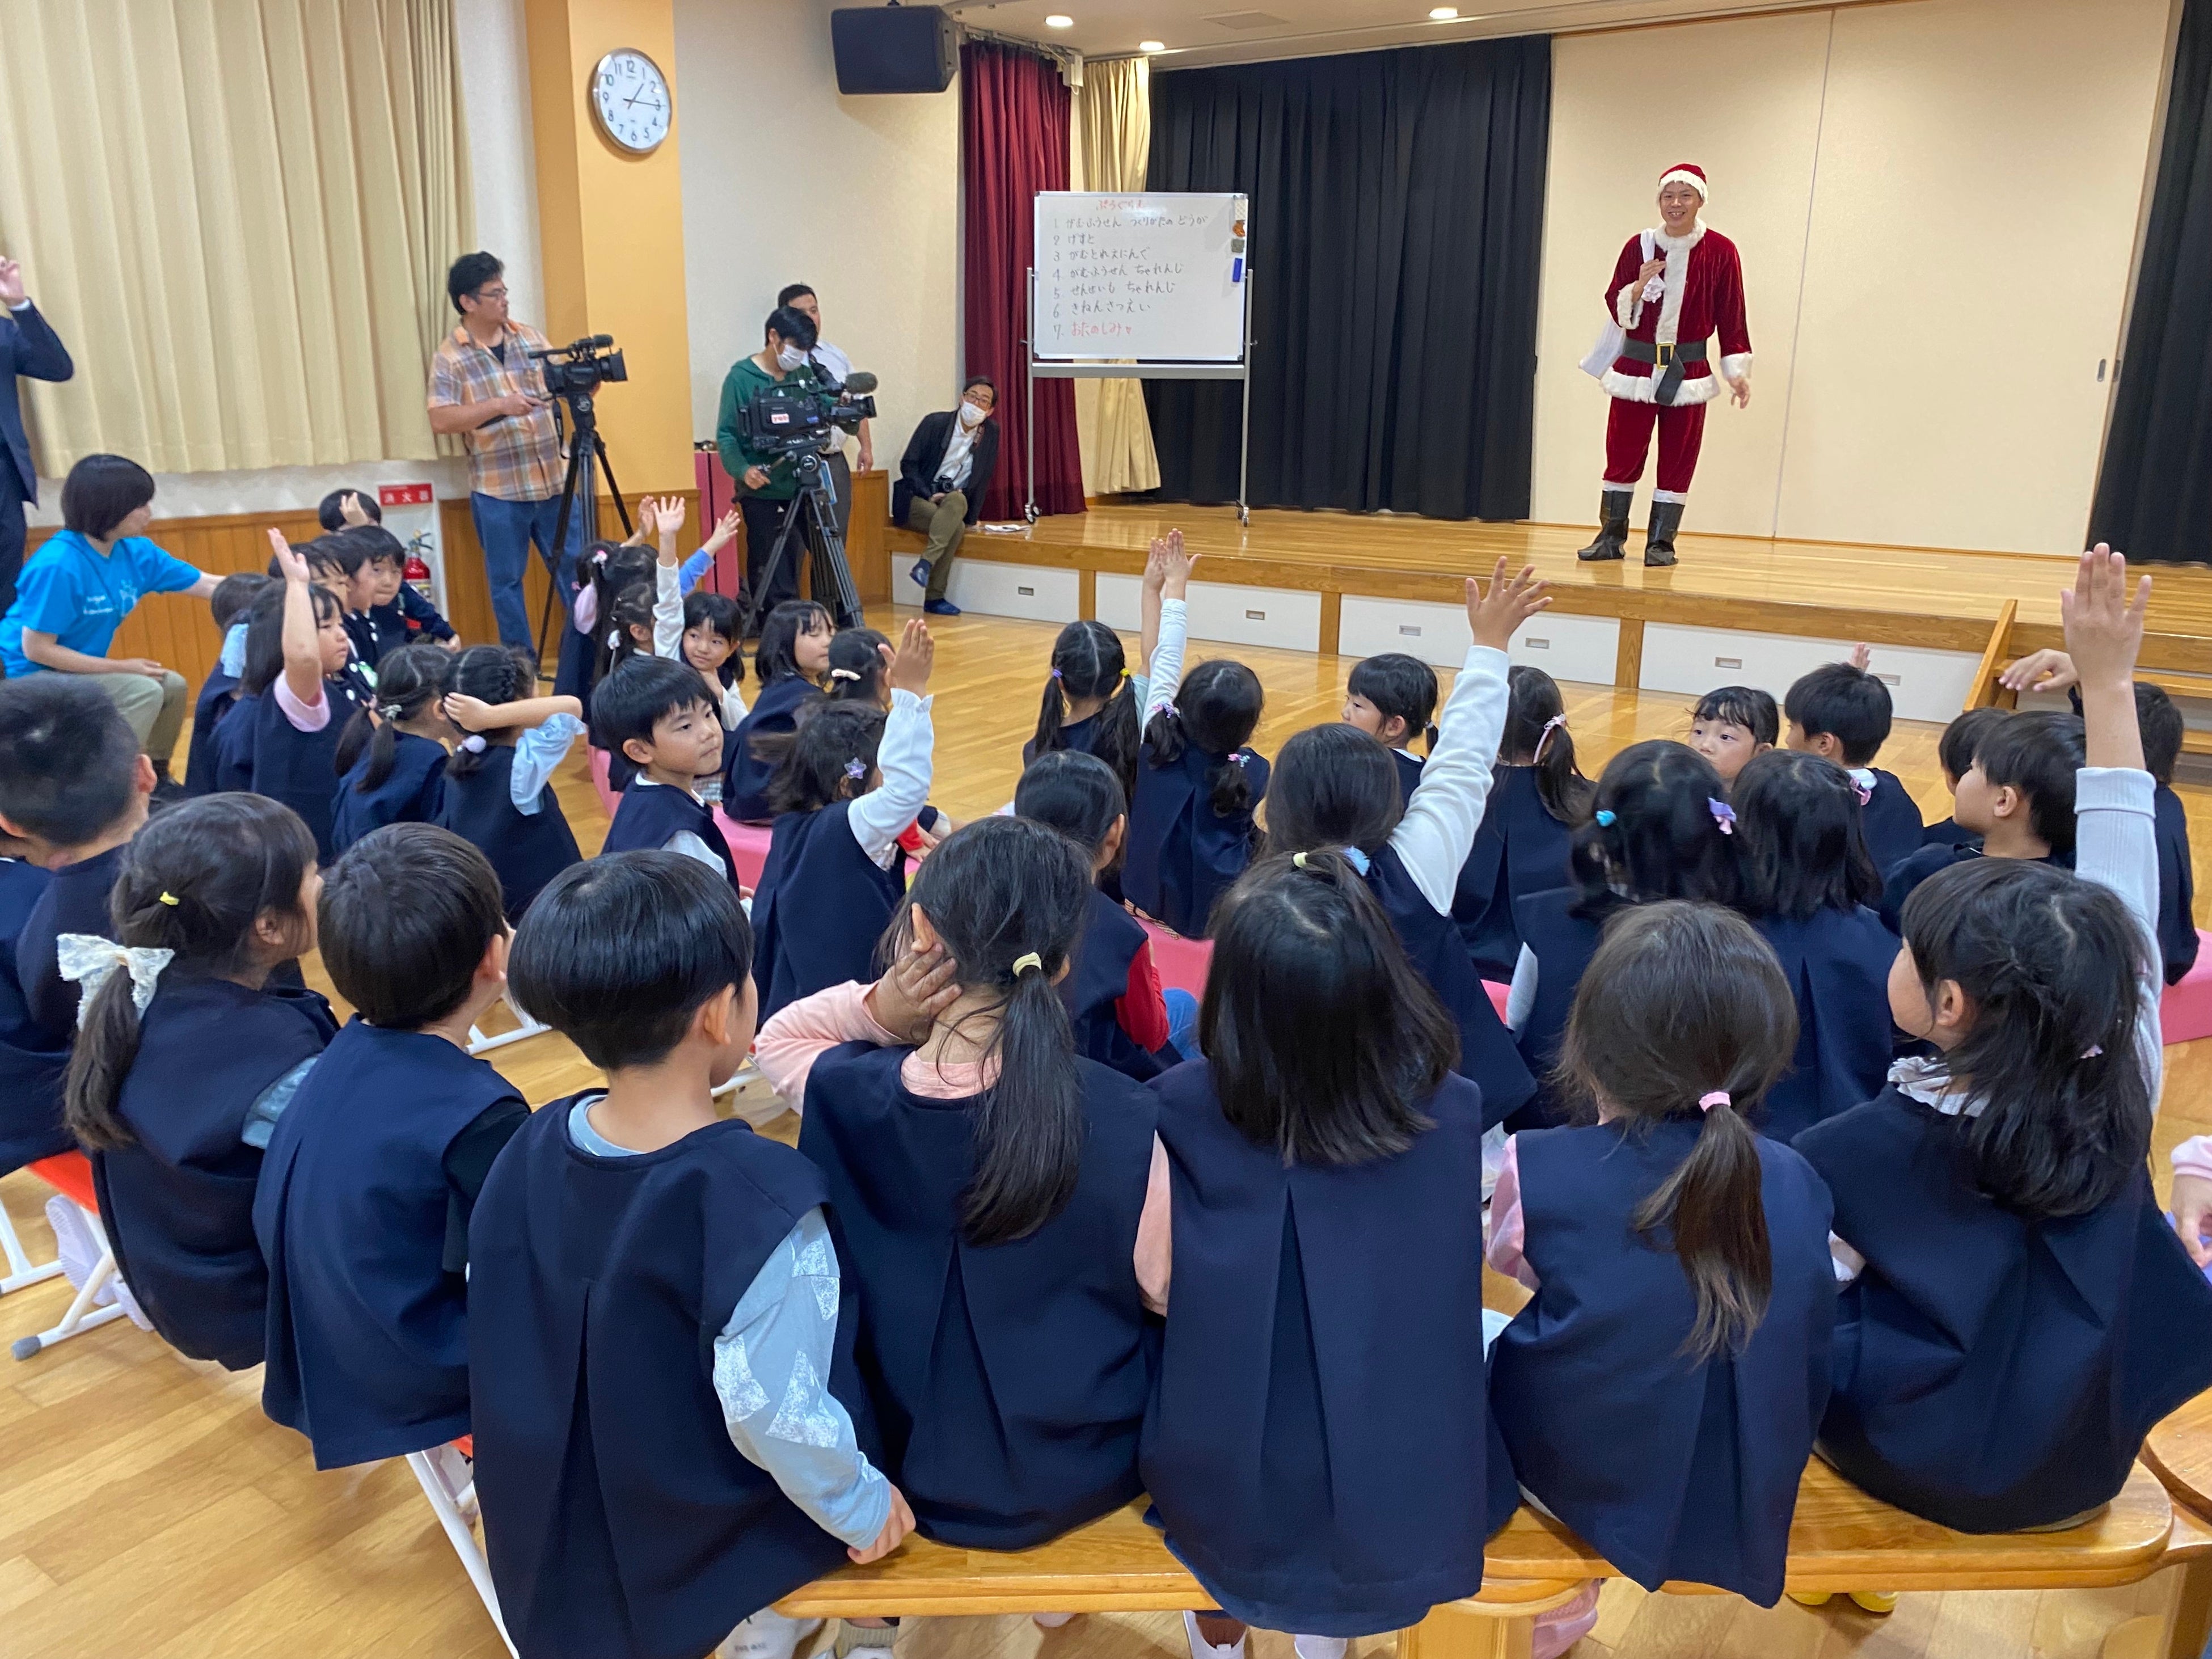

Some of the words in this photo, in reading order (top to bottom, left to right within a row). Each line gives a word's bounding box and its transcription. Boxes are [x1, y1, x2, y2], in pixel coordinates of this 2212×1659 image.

[614, 62, 622, 76] 11
[626, 60, 635, 73] 12
[642, 67, 646, 80] 1
[650, 80, 658, 94] 2
[602, 91, 609, 103] 9
[655, 99, 661, 111] 3
[607, 109, 614, 122] 8
[652, 117, 658, 127] 4
[618, 124, 624, 134] 7
[643, 127, 650, 139] 5
[631, 131, 638, 142] 6
[1178, 214, 1208, 226] どうが
[1068, 233, 1095, 245] げすと
[1053, 251, 1060, 261] 3
[1135, 263, 1184, 276] ちゃれんじ
[1126, 279, 1176, 293] ちゃれんじ
